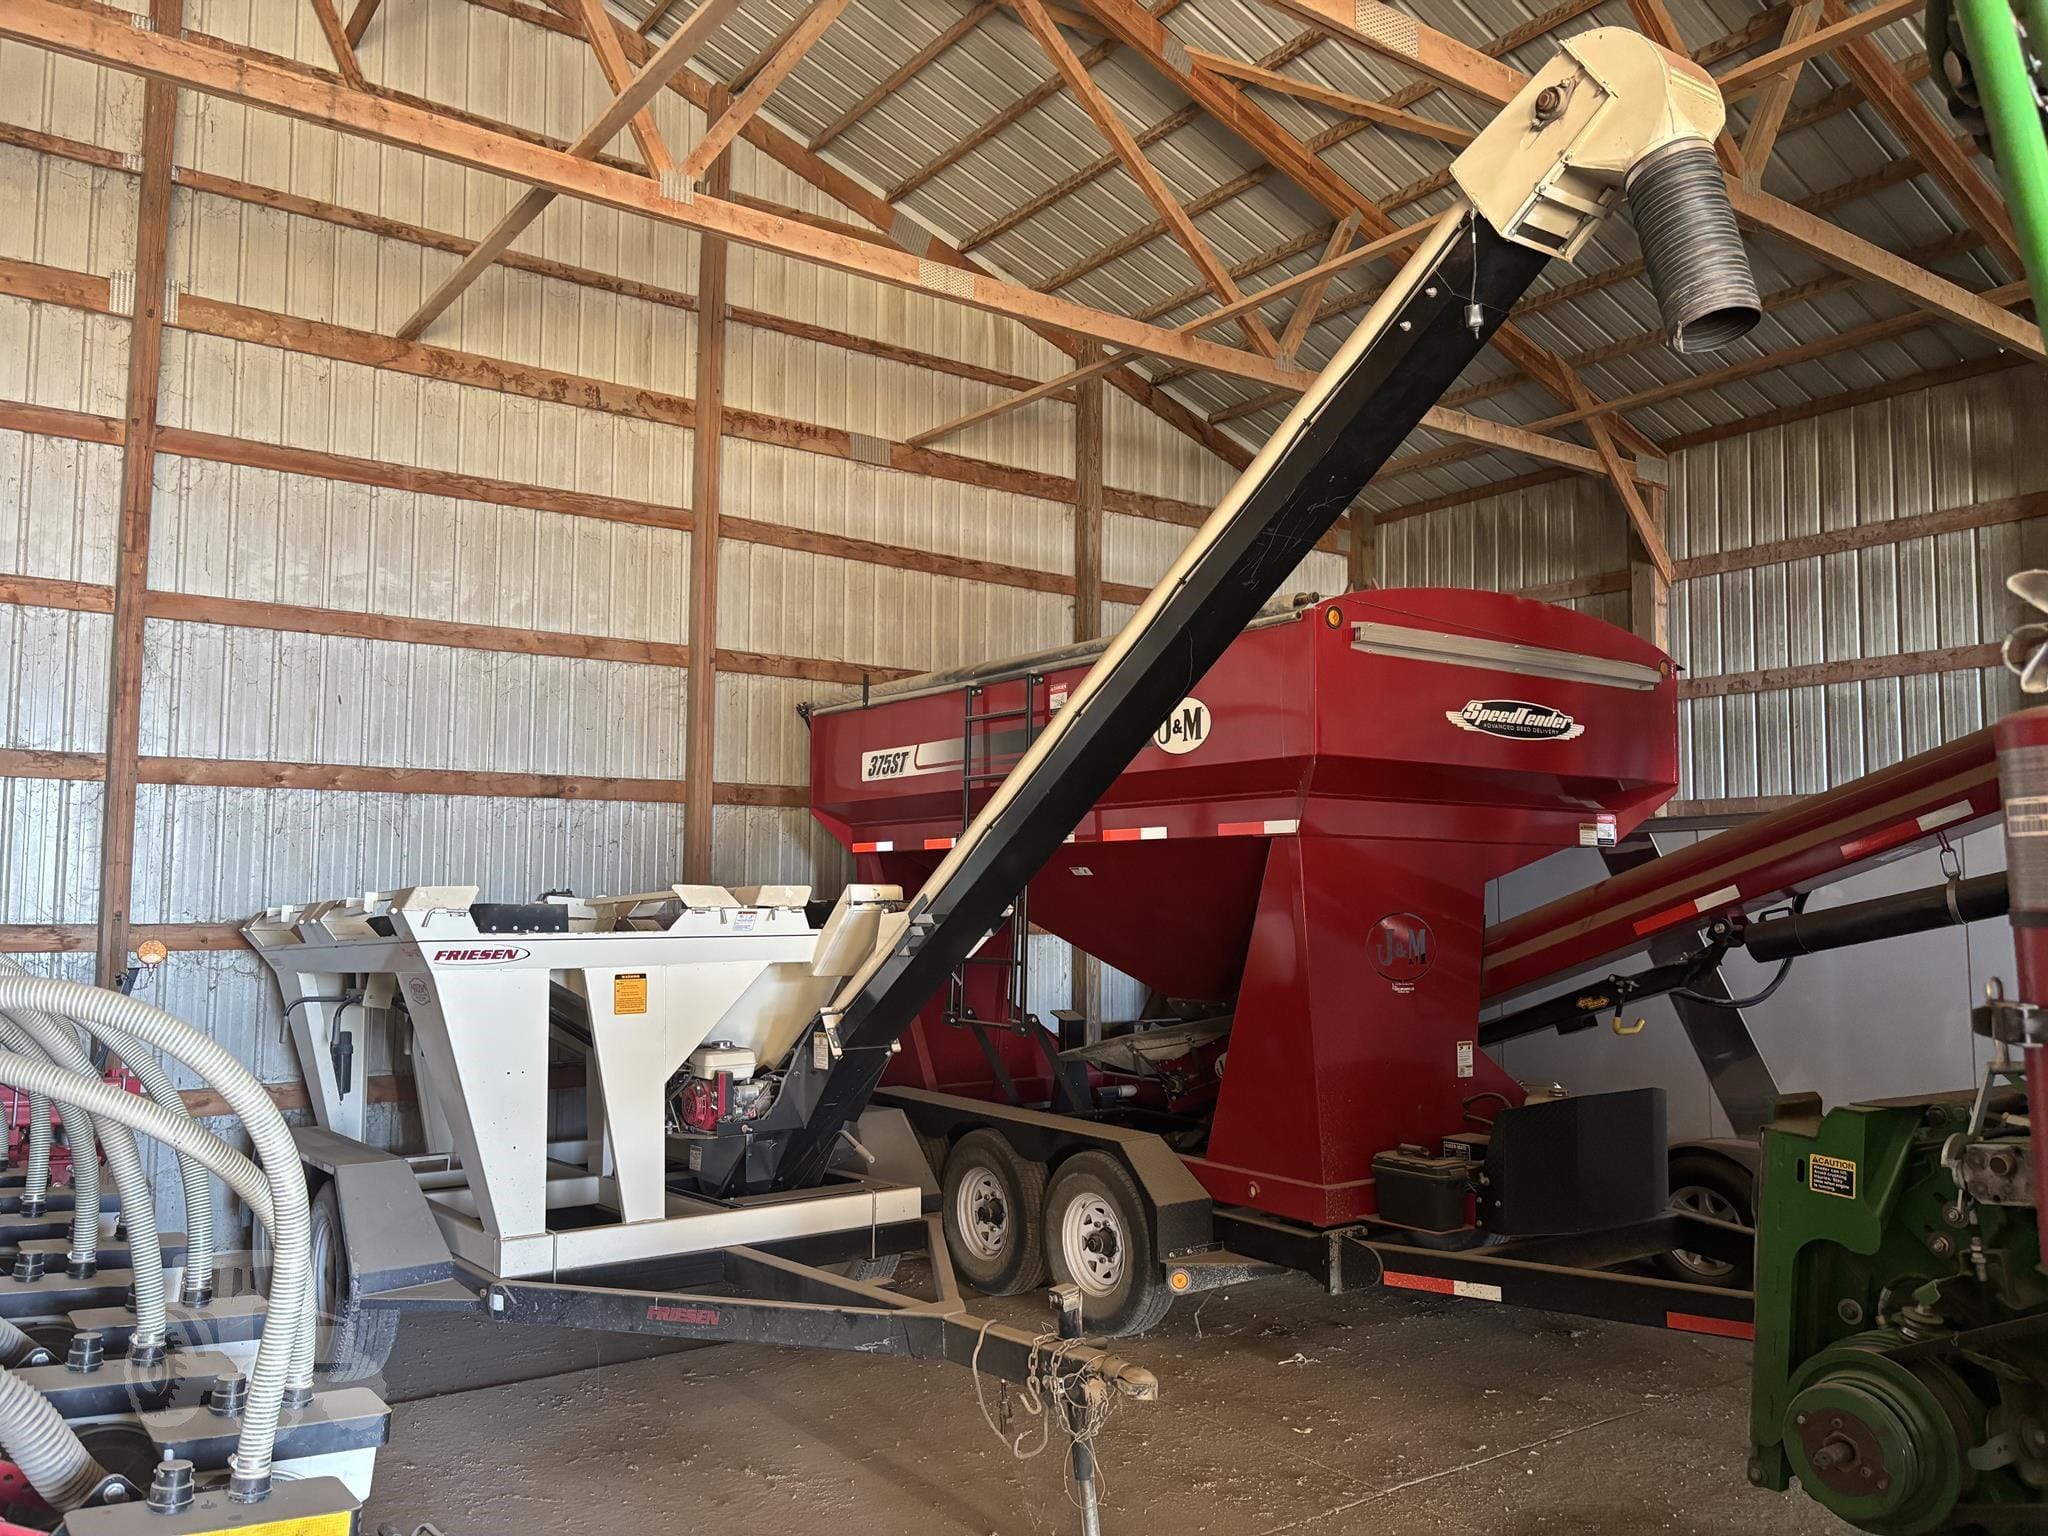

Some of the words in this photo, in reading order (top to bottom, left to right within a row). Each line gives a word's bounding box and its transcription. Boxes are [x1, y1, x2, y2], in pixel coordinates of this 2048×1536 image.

[1158, 706, 1203, 745] J&M
[1463, 703, 1572, 729] SpeedTender
[1483, 723, 1515, 731] ADVANCED
[1533, 727, 1560, 735] DELIVERY
[868, 751, 910, 777] 375ST
[434, 949, 519, 961] FRIESEN
[1376, 928, 1427, 967] J&M
[1818, 1157, 1854, 1170] CAUTION
[646, 1305, 721, 1326] FRIESEN
